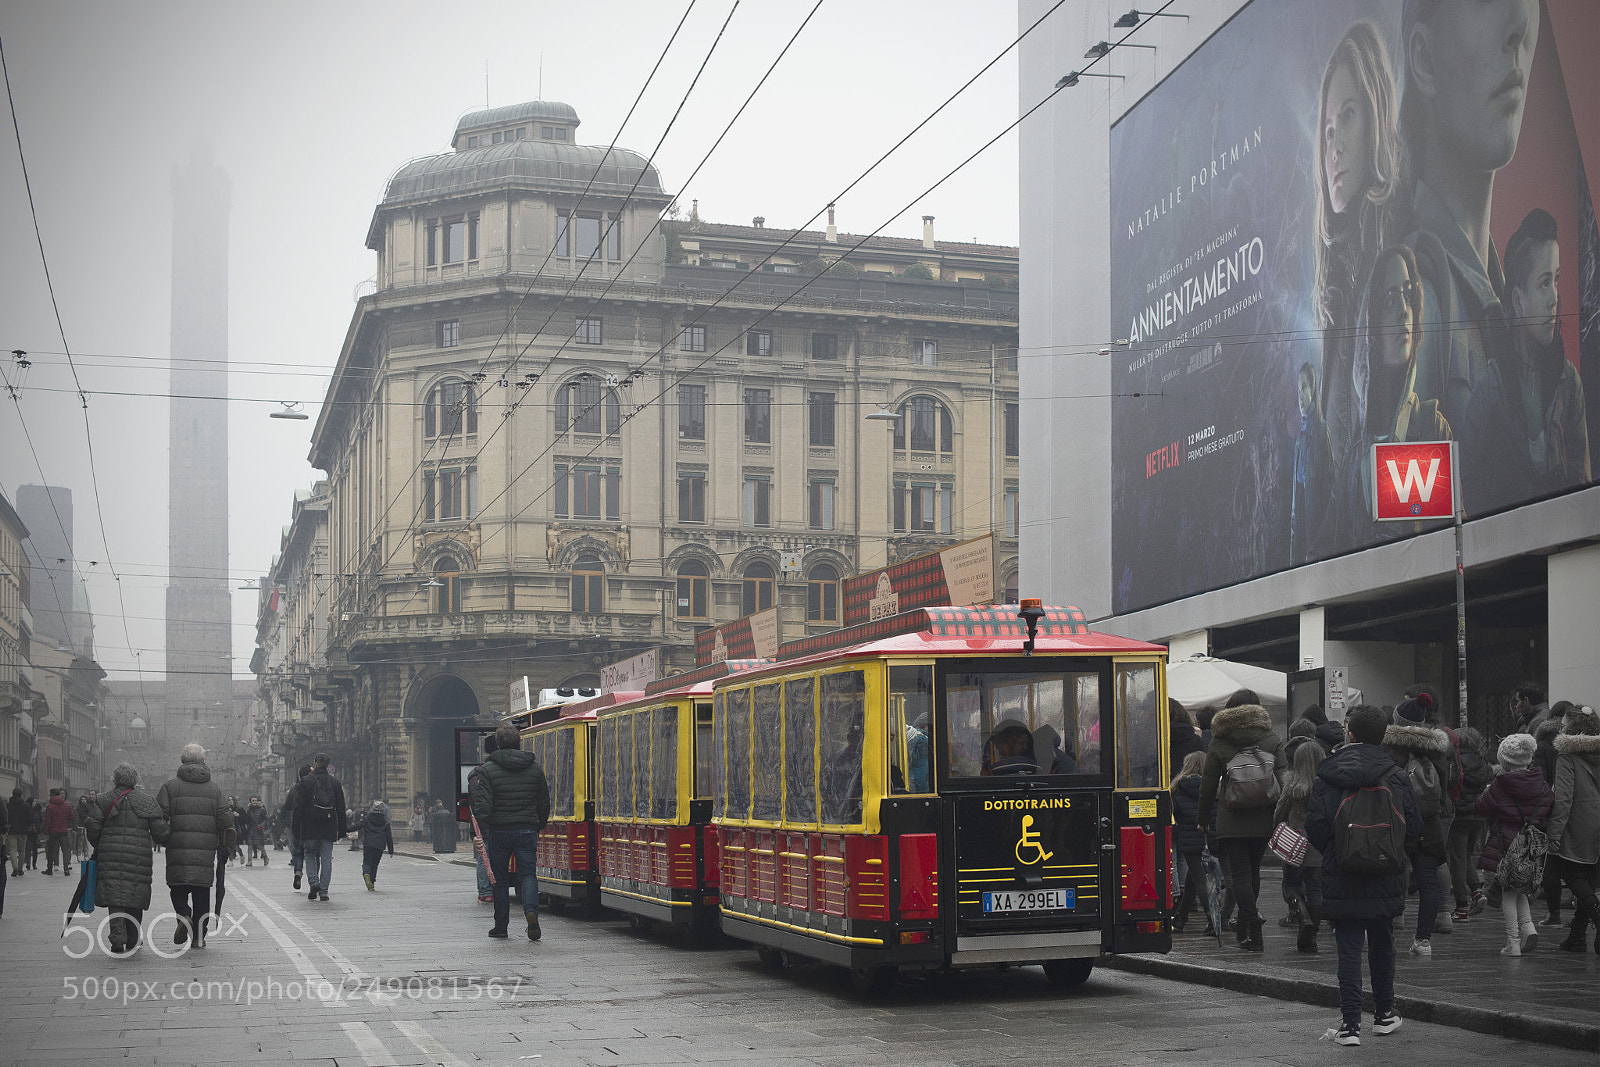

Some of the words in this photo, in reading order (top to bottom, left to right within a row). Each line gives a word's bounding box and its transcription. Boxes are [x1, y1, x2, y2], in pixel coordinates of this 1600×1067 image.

[1128, 187, 1182, 240] NATALIE
[1191, 127, 1262, 193] PORTMAN
[1147, 279, 1157, 294] DAL
[1160, 262, 1184, 286] REGISTA
[1185, 255, 1193, 268] DI
[1129, 237, 1264, 349] ANNIENTAMENTO
[1128, 356, 1146, 374] NULLA
[1191, 318, 1213, 338] TUTTO
[1214, 312, 1221, 325] TI
[498, 380, 509, 388] 13
[606, 377, 618, 386] 14
[1187, 434, 1195, 446] 12
[1195, 425, 1216, 443] MARZO
[1187, 448, 1204, 462] PRIMO
[1204, 440, 1218, 455] MESE
[1218, 429, 1245, 450] GRATUITO
[1146, 440, 1180, 480] NETFLIX
[1385, 458, 1441, 504] W
[984, 798, 1071, 811] DOTTOTRAINS
[994, 894, 1013, 911] XA
[1018, 891, 1065, 910] 299EL
